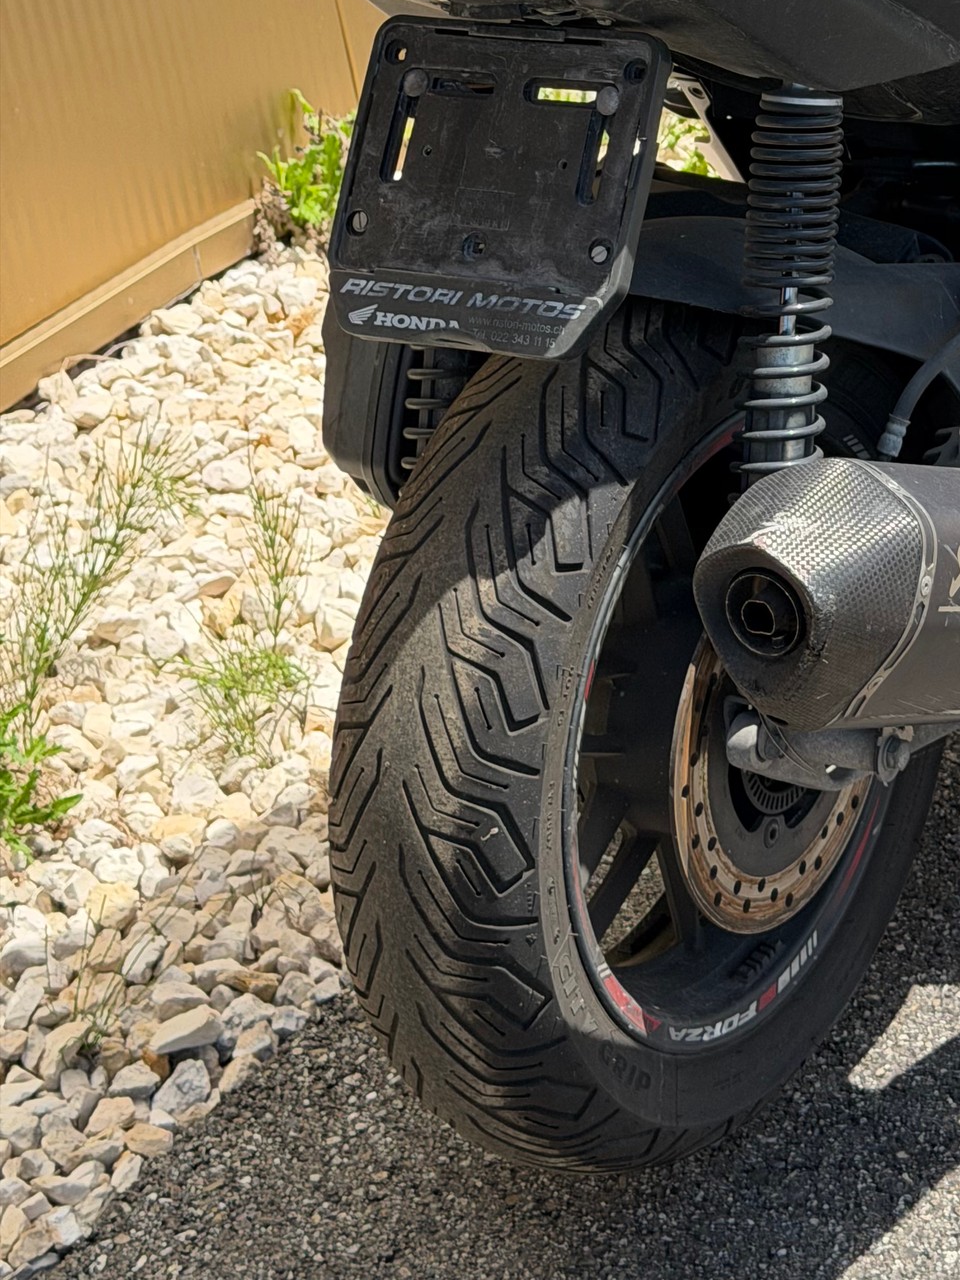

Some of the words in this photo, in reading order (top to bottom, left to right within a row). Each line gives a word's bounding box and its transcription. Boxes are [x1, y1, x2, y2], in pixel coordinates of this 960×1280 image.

[339, 277, 464, 306] RISTORI
[466, 291, 588, 320] MOTOS
[373, 311, 460, 331] HONDA
[490, 330, 509, 343] 022
[511, 332, 530, 345] 343
[534, 334, 542, 347] 11
[545, 337, 556, 349] 15
[668, 1000, 759, 1043] FORZA
